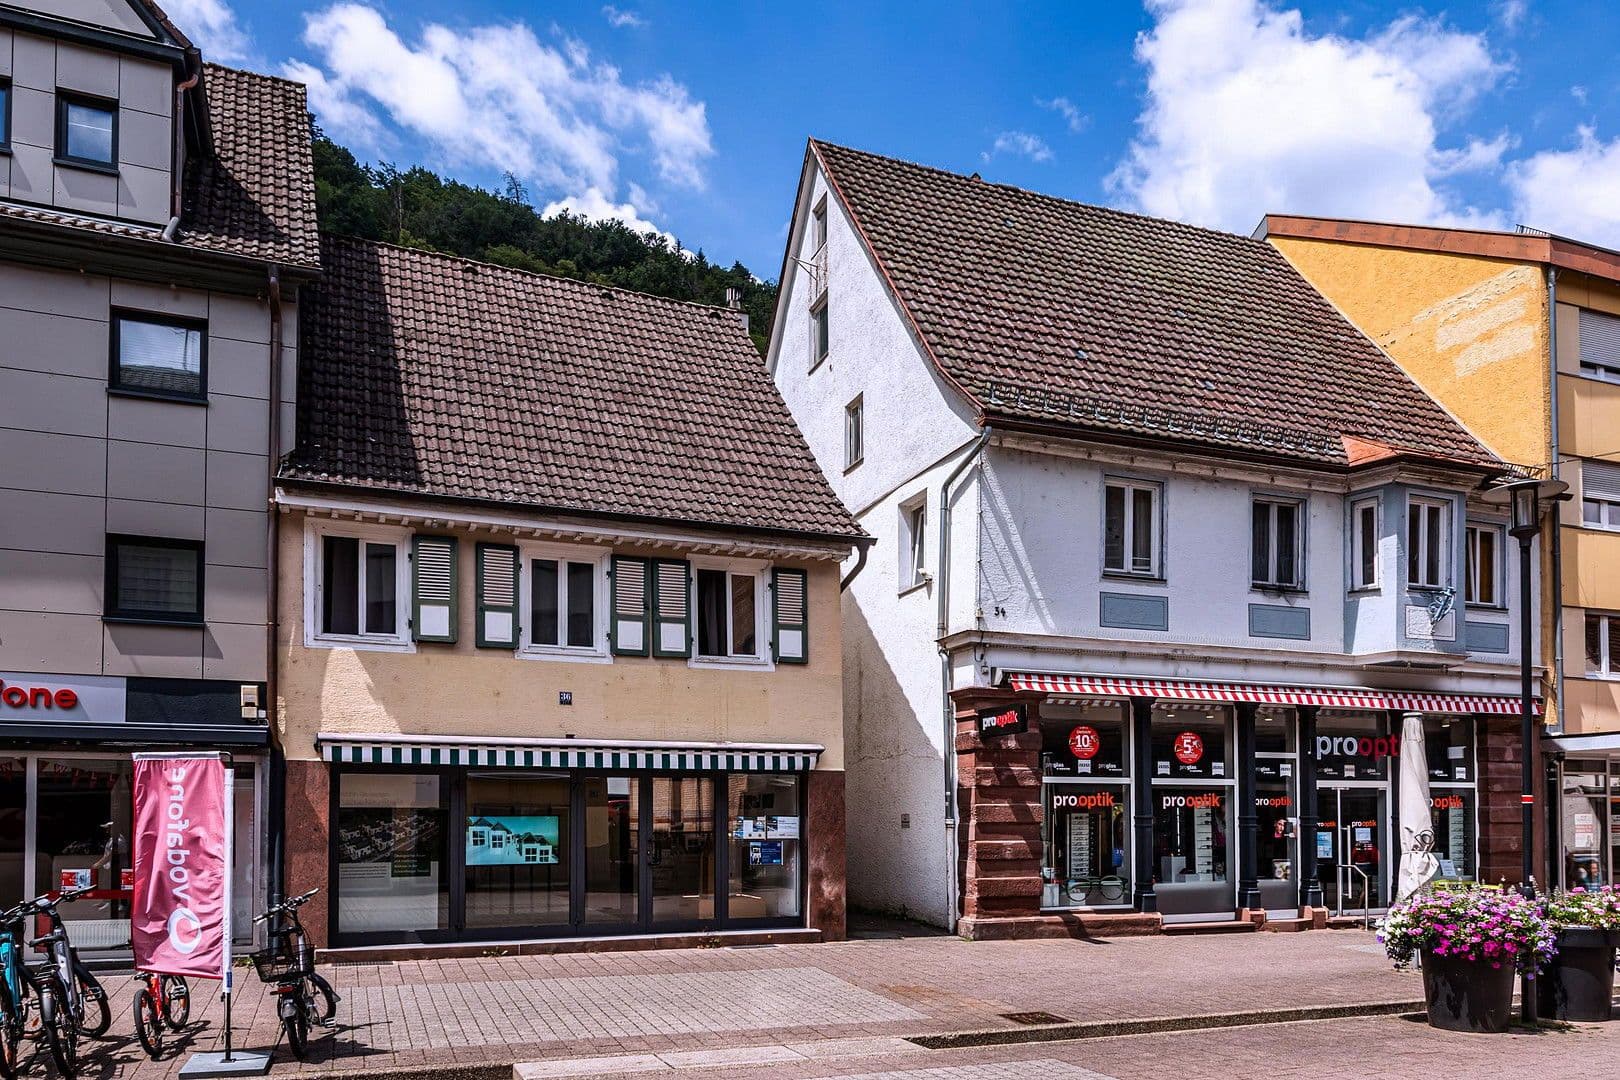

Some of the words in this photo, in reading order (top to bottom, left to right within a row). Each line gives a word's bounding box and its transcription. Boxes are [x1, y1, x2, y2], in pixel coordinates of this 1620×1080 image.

[994, 606, 1007, 617] 34
[1316, 732, 1400, 761] proopt
[1429, 794, 1464, 810] optik
